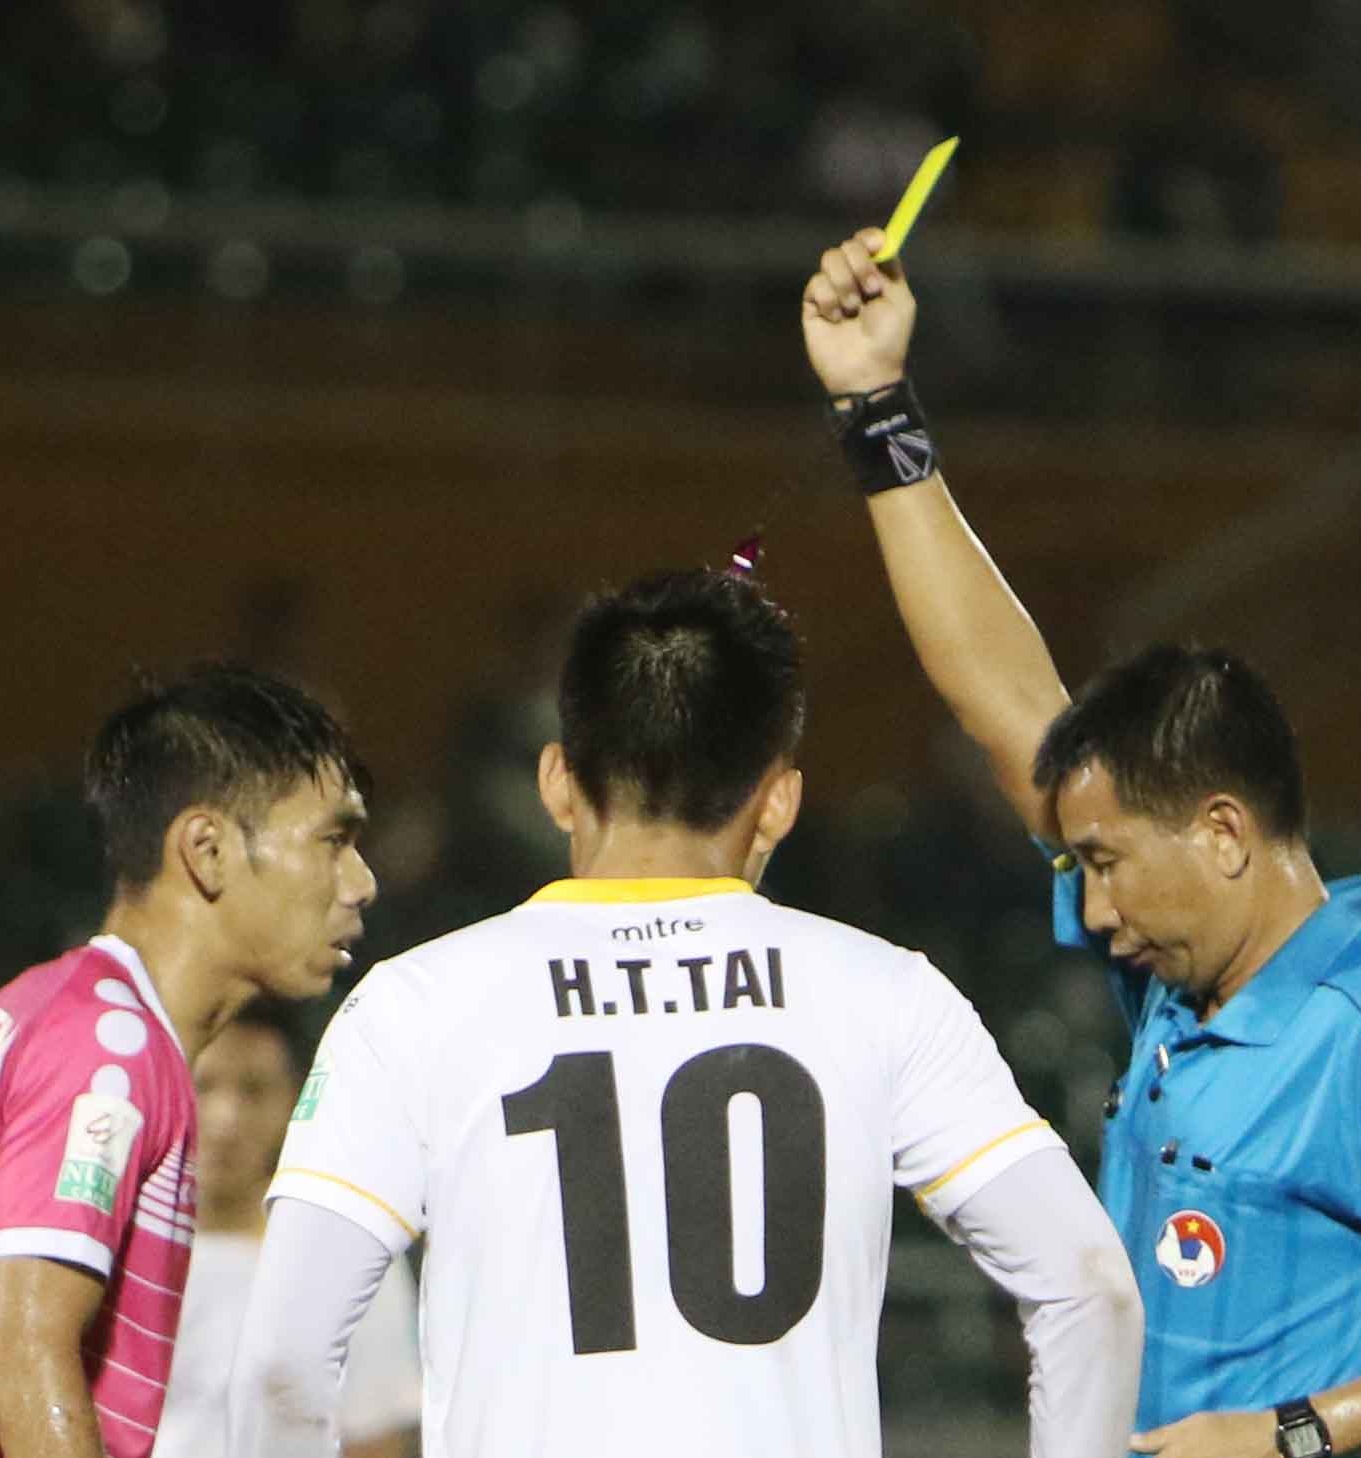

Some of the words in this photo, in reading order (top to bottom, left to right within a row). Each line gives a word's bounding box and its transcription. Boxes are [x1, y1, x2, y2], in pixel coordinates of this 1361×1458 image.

[611, 916, 707, 943] mitre
[548, 946, 786, 1018] H.T.TAI
[500, 1042, 827, 1356] 10
